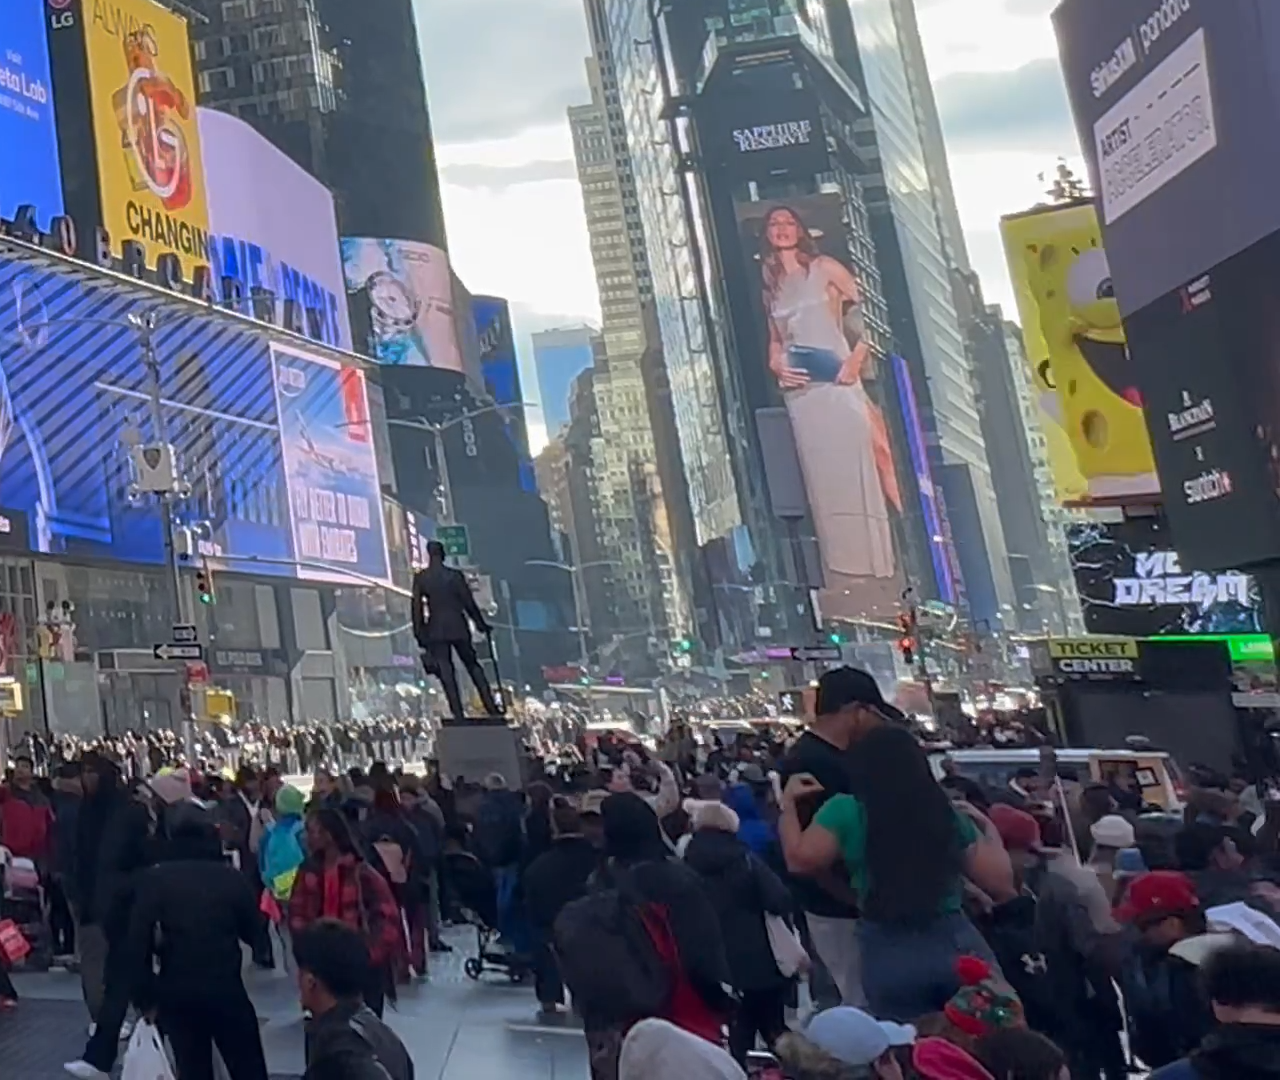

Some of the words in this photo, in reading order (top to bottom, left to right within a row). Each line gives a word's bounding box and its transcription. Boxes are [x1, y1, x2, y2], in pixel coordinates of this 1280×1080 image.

[50, 11, 74, 28] LG
[20, 72, 48, 105] Lab
[732, 120, 812, 143] SAPPHIRE
[739, 132, 810, 153] RESERVE
[1112, 572, 1251, 608] DREAM
[1056, 641, 1130, 656] TICKET
[1058, 659, 1135, 673] CENTER
